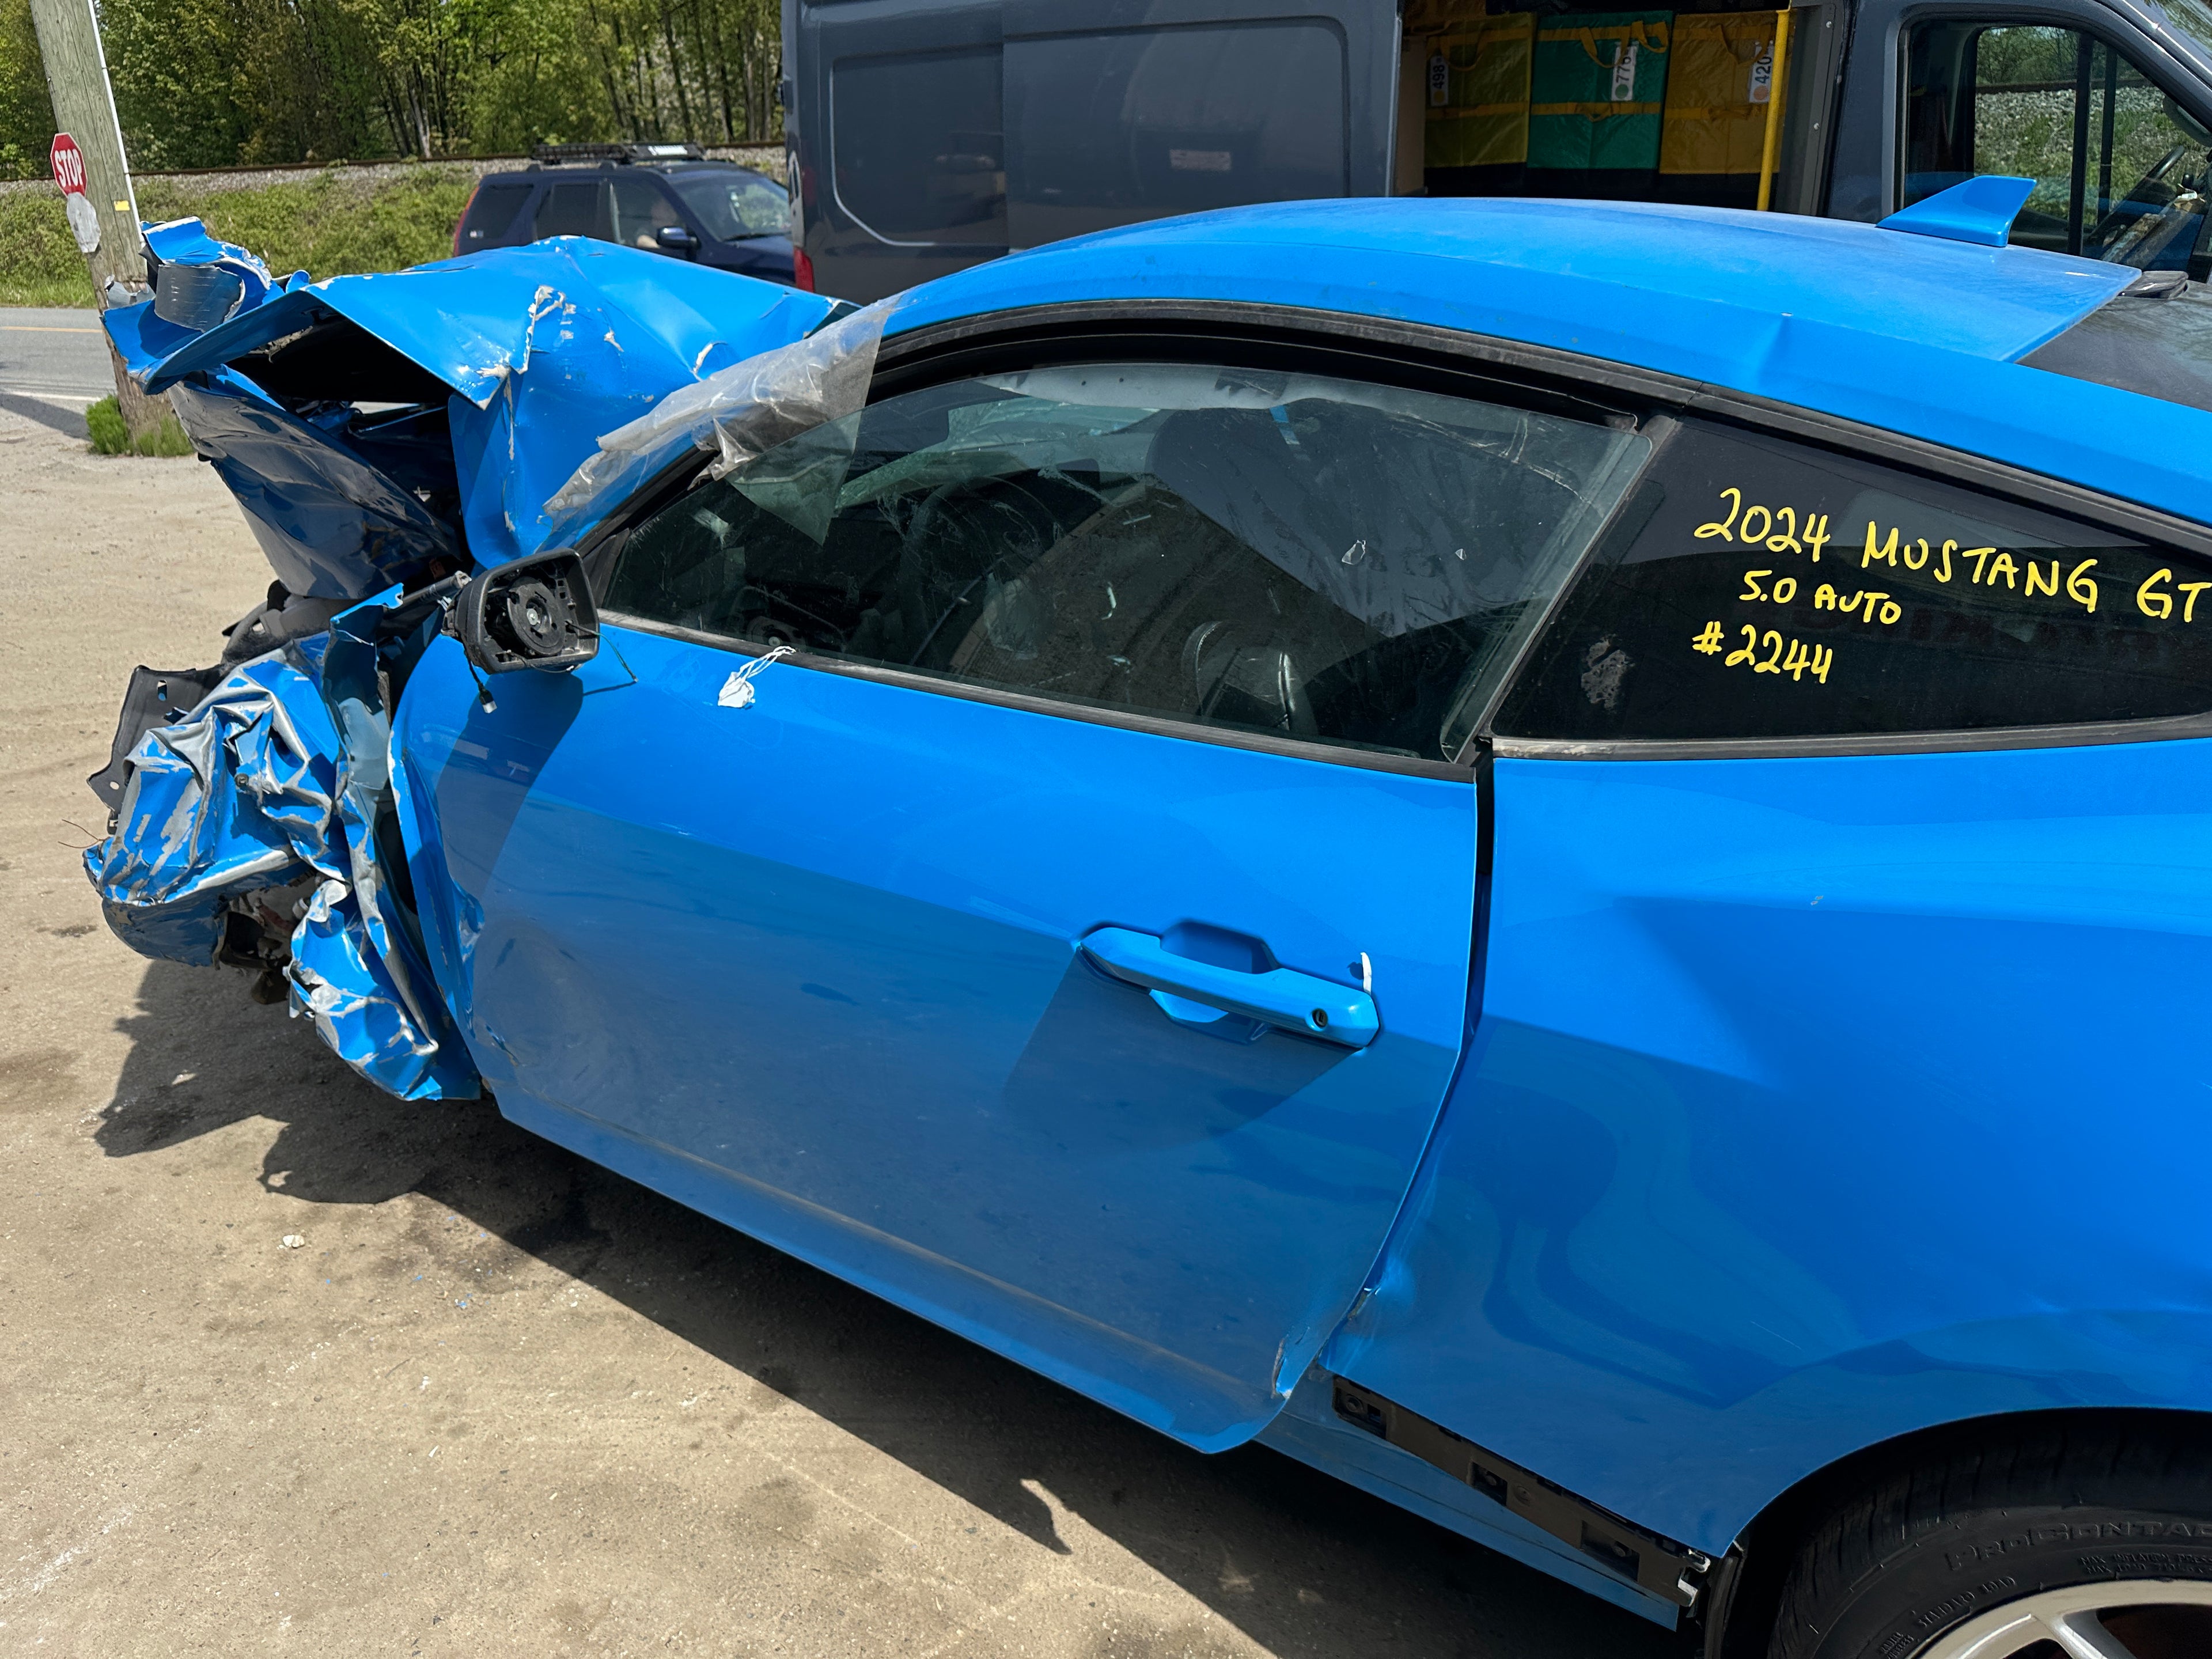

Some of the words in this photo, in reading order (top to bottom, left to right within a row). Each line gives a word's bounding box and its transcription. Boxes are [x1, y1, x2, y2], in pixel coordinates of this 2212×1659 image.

[1432, 65, 1445, 89] 498
[1755, 56, 1772, 84] 420
[54, 148, 84, 188] STOP
[1694, 487, 1830, 562] 2024
[1861, 521, 2099, 613] MUSTANG
[2136, 567, 2212, 622] GT
[1739, 569, 1797, 604] 5.0
[1814, 583, 1902, 625] AUTO
[1692, 620, 1833, 684] #2244
